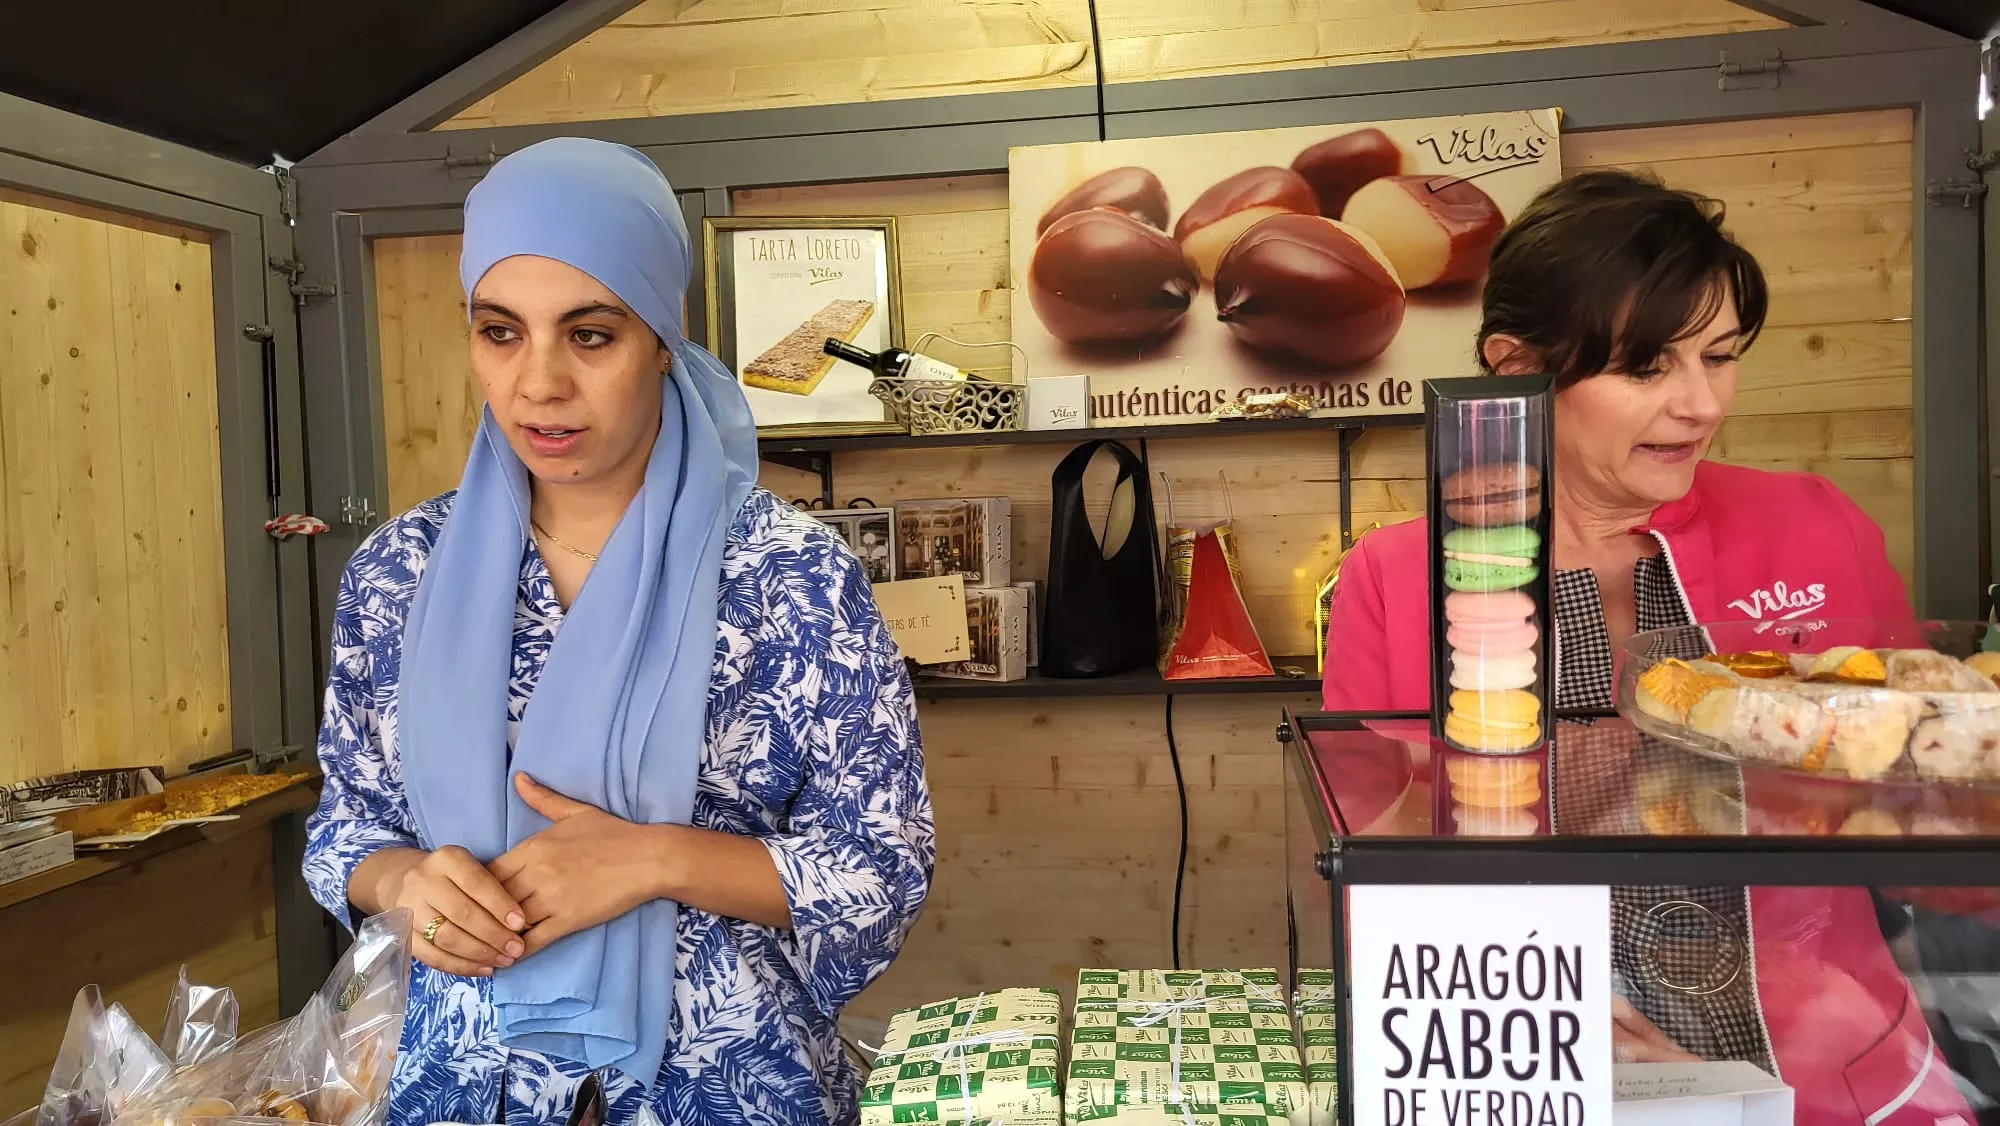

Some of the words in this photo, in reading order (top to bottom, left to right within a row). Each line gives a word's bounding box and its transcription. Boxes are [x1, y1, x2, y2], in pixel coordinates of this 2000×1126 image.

[1417, 125, 1548, 166] Vilas
[749, 237, 797, 261] TARTA
[806, 235, 861, 261] LORETO
[808, 267, 844, 279] Vilas
[1379, 377, 1412, 406] de
[1050, 407, 1078, 420] Vilas
[1726, 580, 1826, 620] Vilas
[908, 617, 918, 629] DE
[1382, 930, 1583, 1001] ARAGÓN
[1381, 1007, 1584, 1082] SABOR
[1385, 1088, 1427, 1126] DE
[1441, 1089, 1585, 1126] VERDAD
